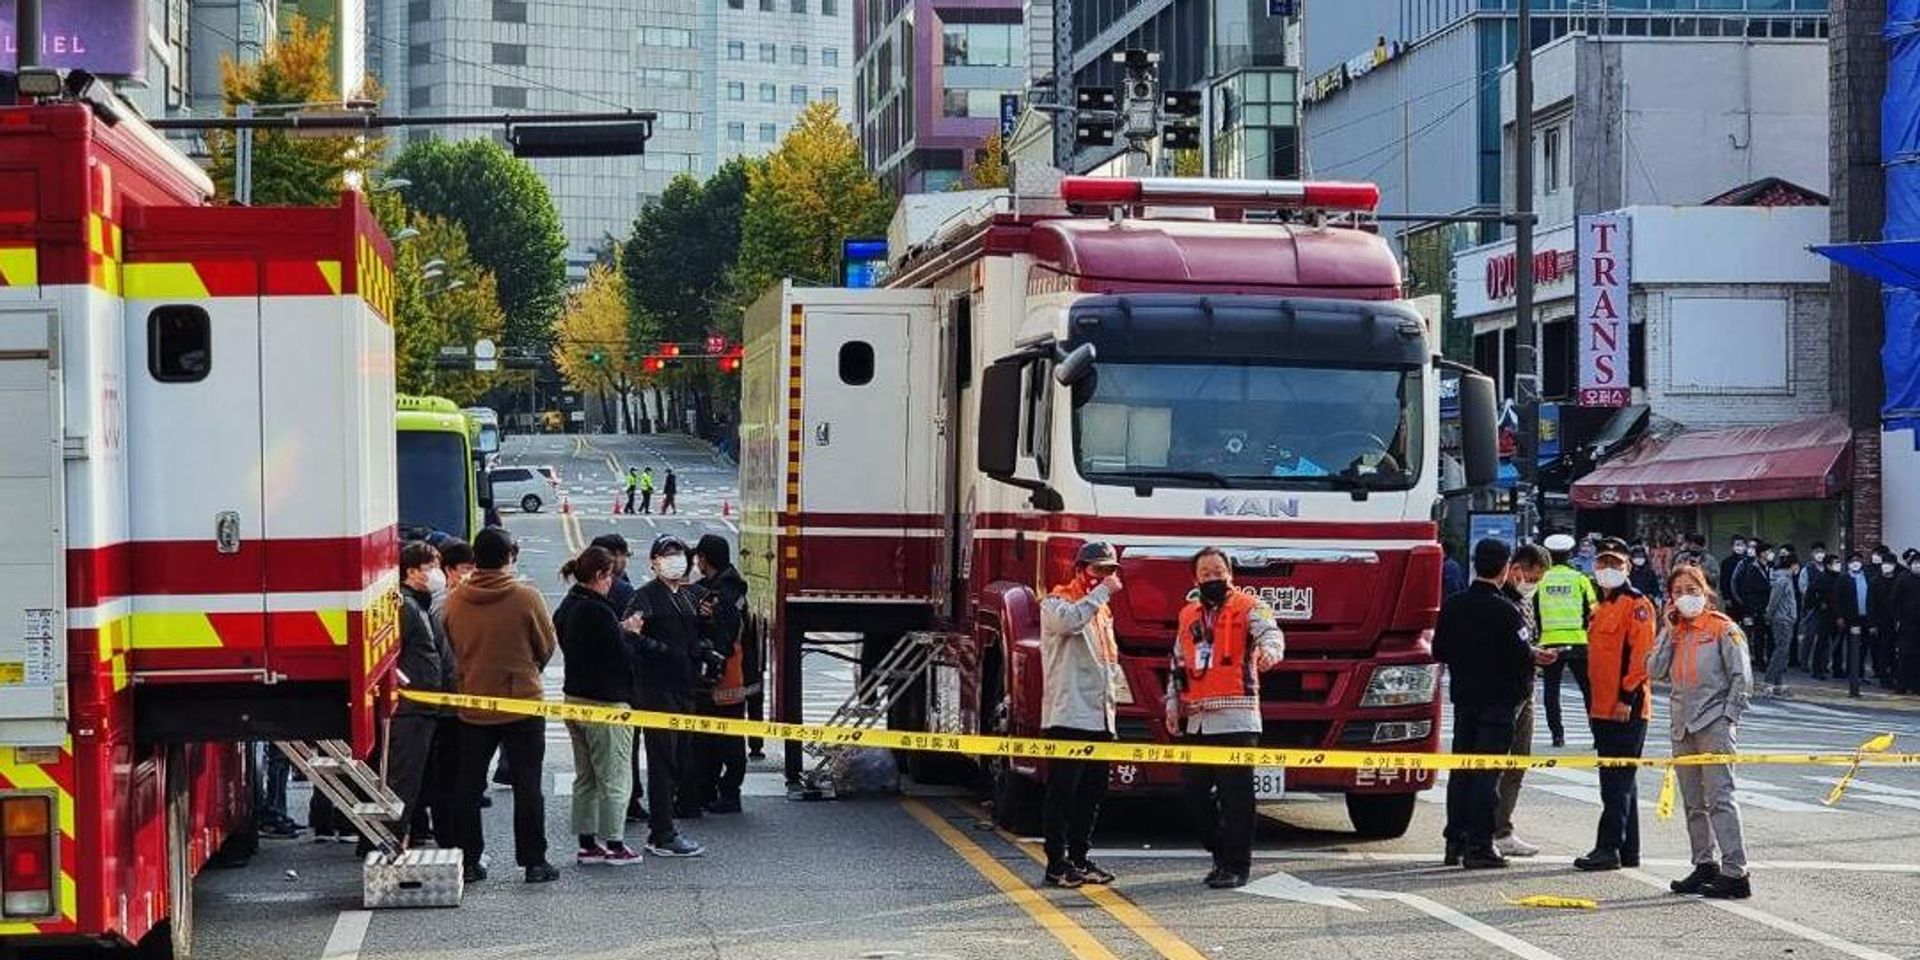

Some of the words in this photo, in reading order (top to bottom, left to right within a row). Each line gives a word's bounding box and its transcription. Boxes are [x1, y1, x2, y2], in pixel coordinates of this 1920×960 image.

[1590, 223, 1618, 384] TRANS
[1204, 497, 1298, 517] MAN
[1237, 586, 1312, 611] 특별시
[764, 725, 825, 740] 서울소방
[997, 741, 1057, 755] 서울소방
[1227, 752, 1287, 764] 서울소방
